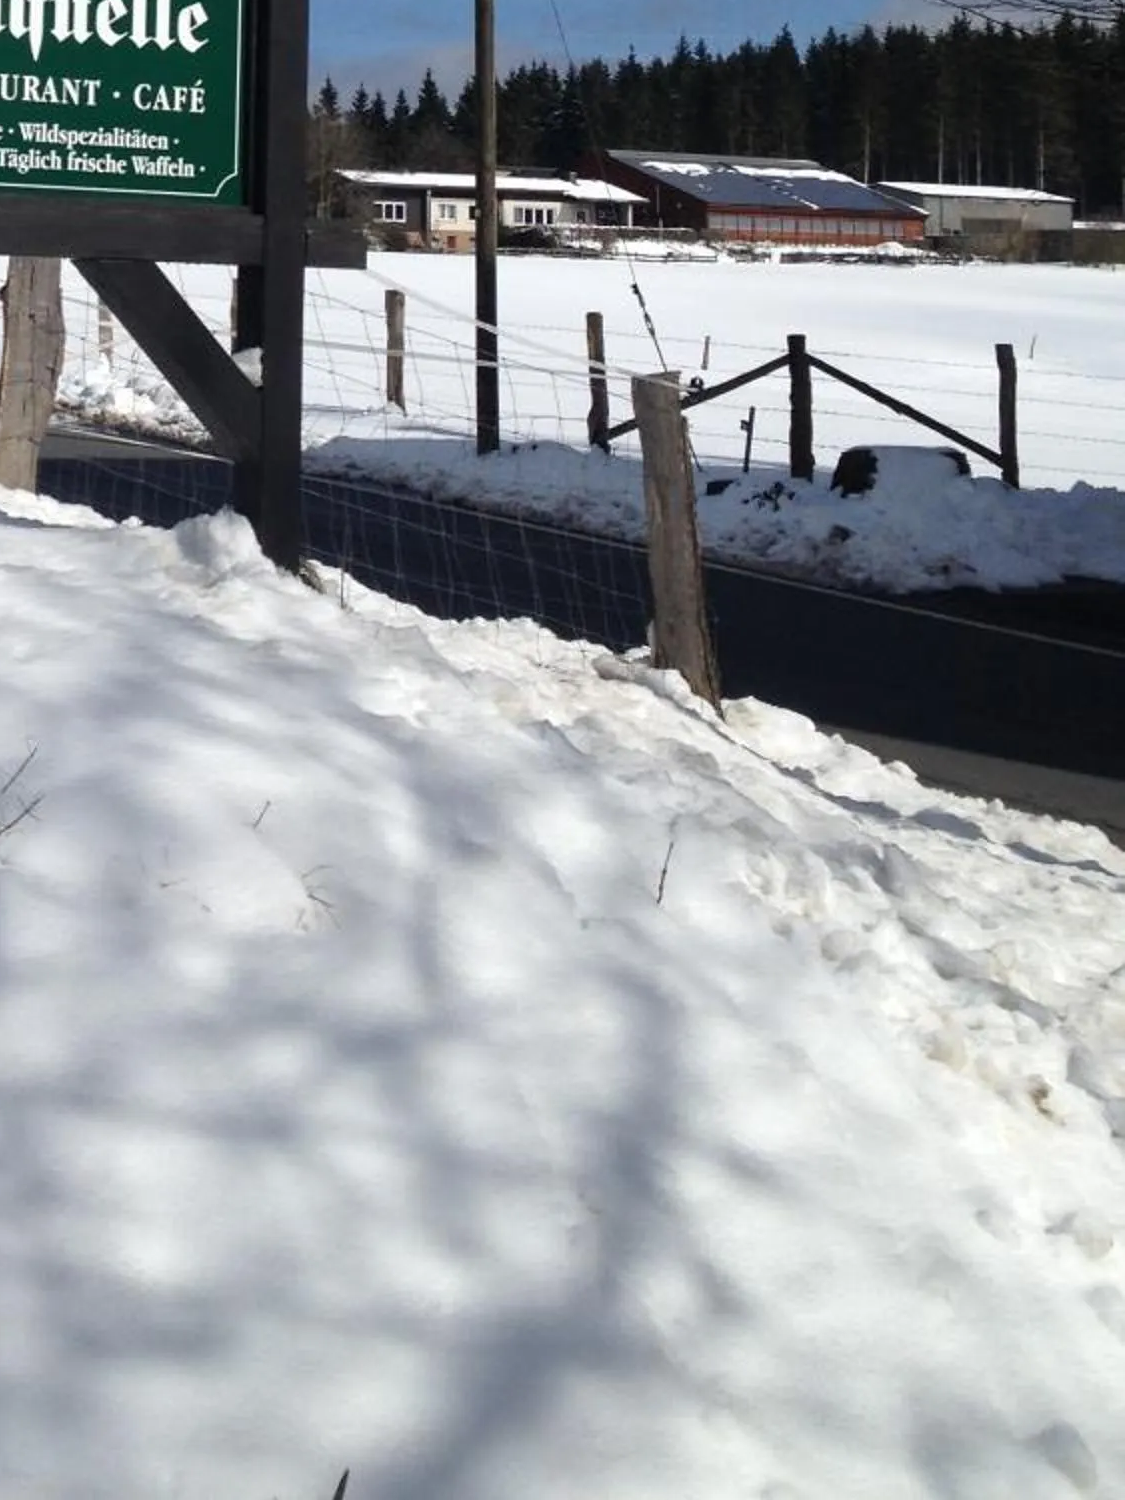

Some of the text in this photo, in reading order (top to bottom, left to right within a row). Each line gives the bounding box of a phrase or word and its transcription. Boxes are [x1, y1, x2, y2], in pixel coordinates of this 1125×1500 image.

[132, 79, 206, 114] CAFÉ
[18, 121, 169, 151] Wildspezialitäten
[66, 151, 128, 175] frische
[130, 155, 196, 178] Waffeln
